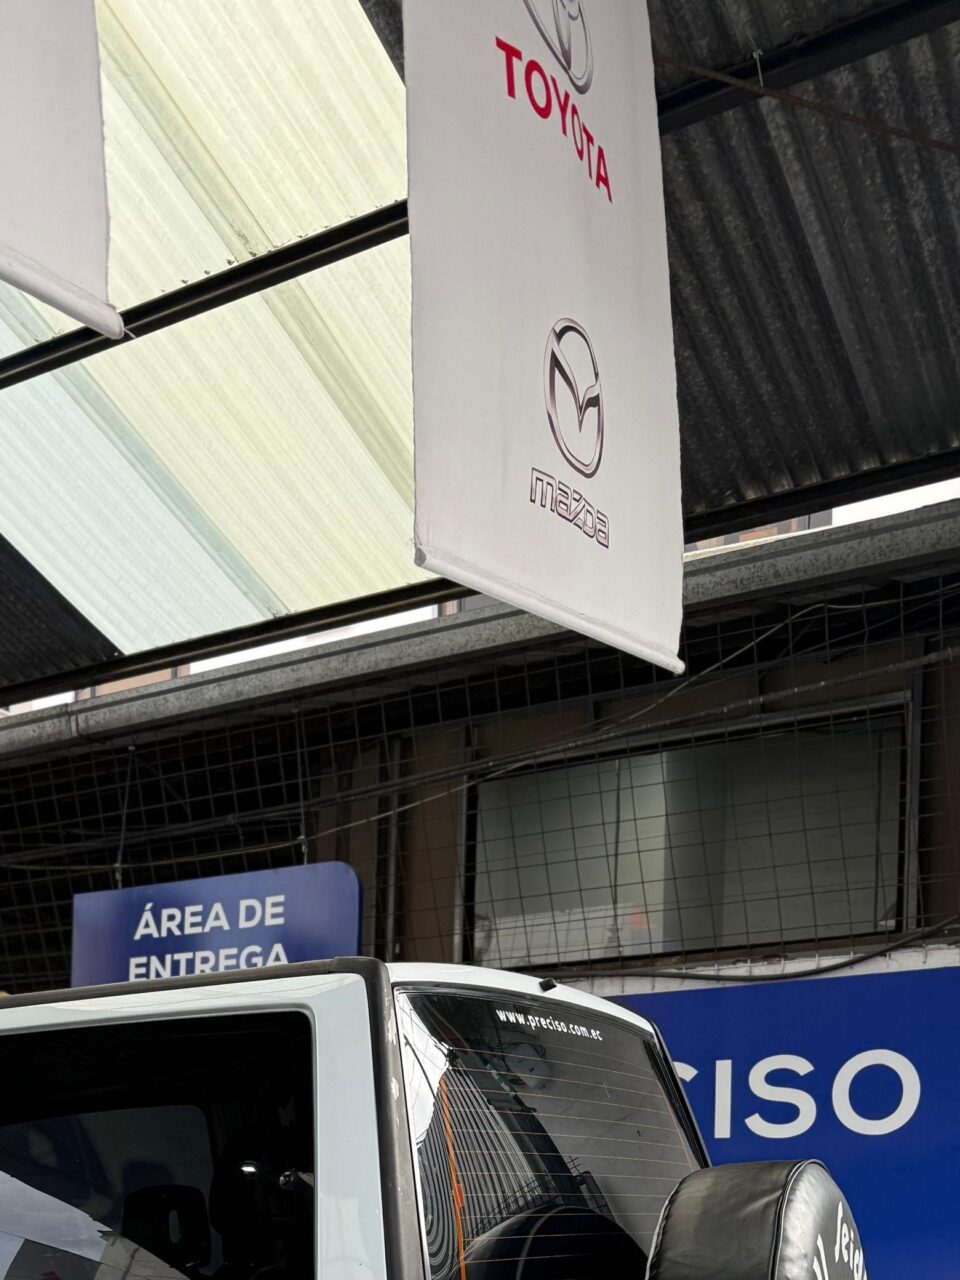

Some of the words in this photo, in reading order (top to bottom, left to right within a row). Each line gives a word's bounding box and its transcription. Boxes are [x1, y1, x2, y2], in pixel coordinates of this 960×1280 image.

[495, 36, 613, 203] TOYOTA
[529, 467, 610, 549] mazda
[133, 902, 230, 941] ÁREA
[239, 895, 286, 929] DE
[128, 943, 289, 982] ENTREGA
[496, 1009, 602, 1041] www.preciso.com.ec
[673, 1049, 921, 1140] ISO
